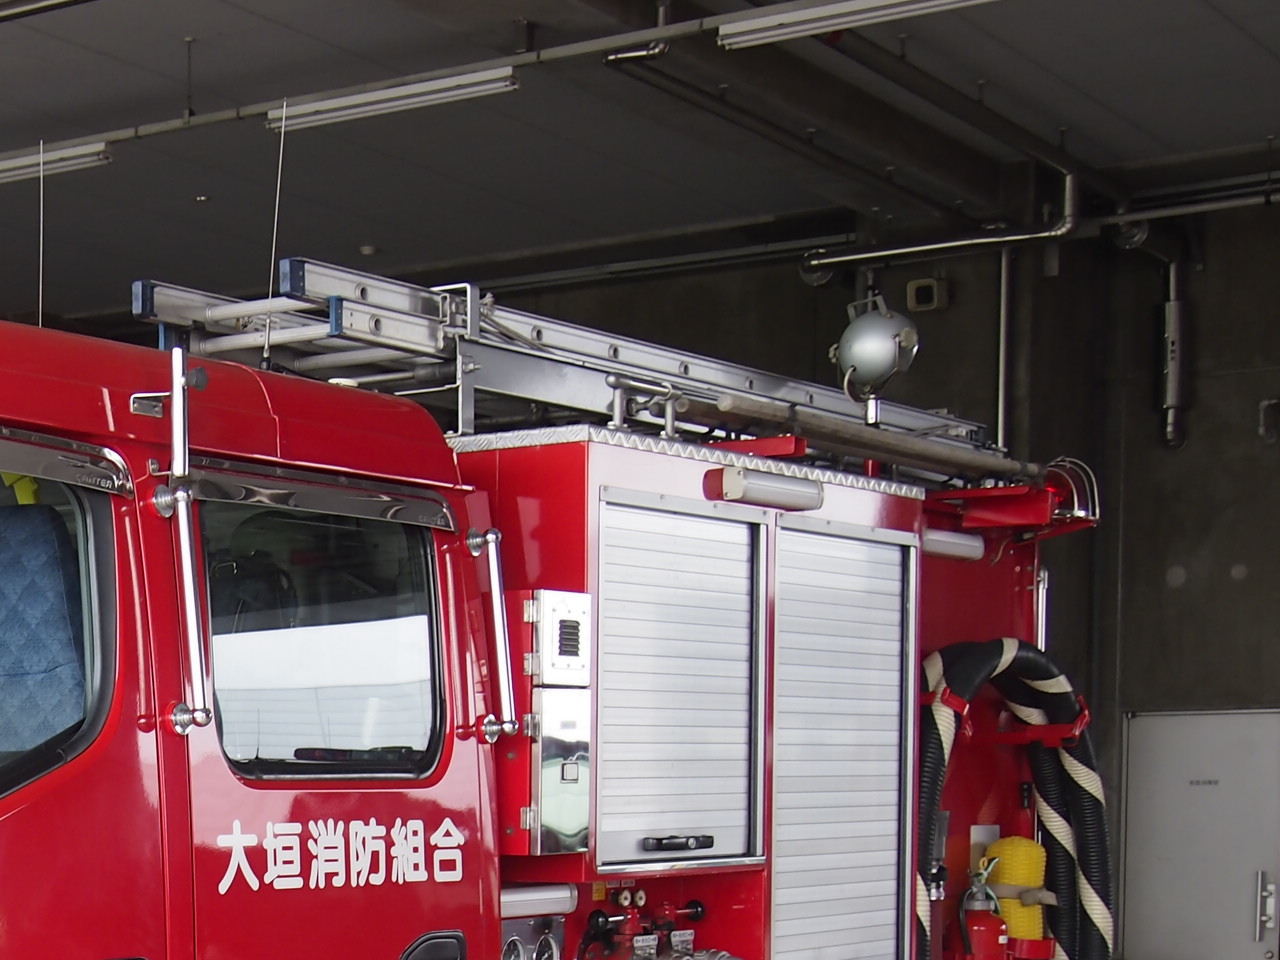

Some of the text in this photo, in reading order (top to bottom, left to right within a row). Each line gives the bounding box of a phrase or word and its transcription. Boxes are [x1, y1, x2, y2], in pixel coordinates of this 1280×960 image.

[216, 817, 465, 895] 大垣消防組合
